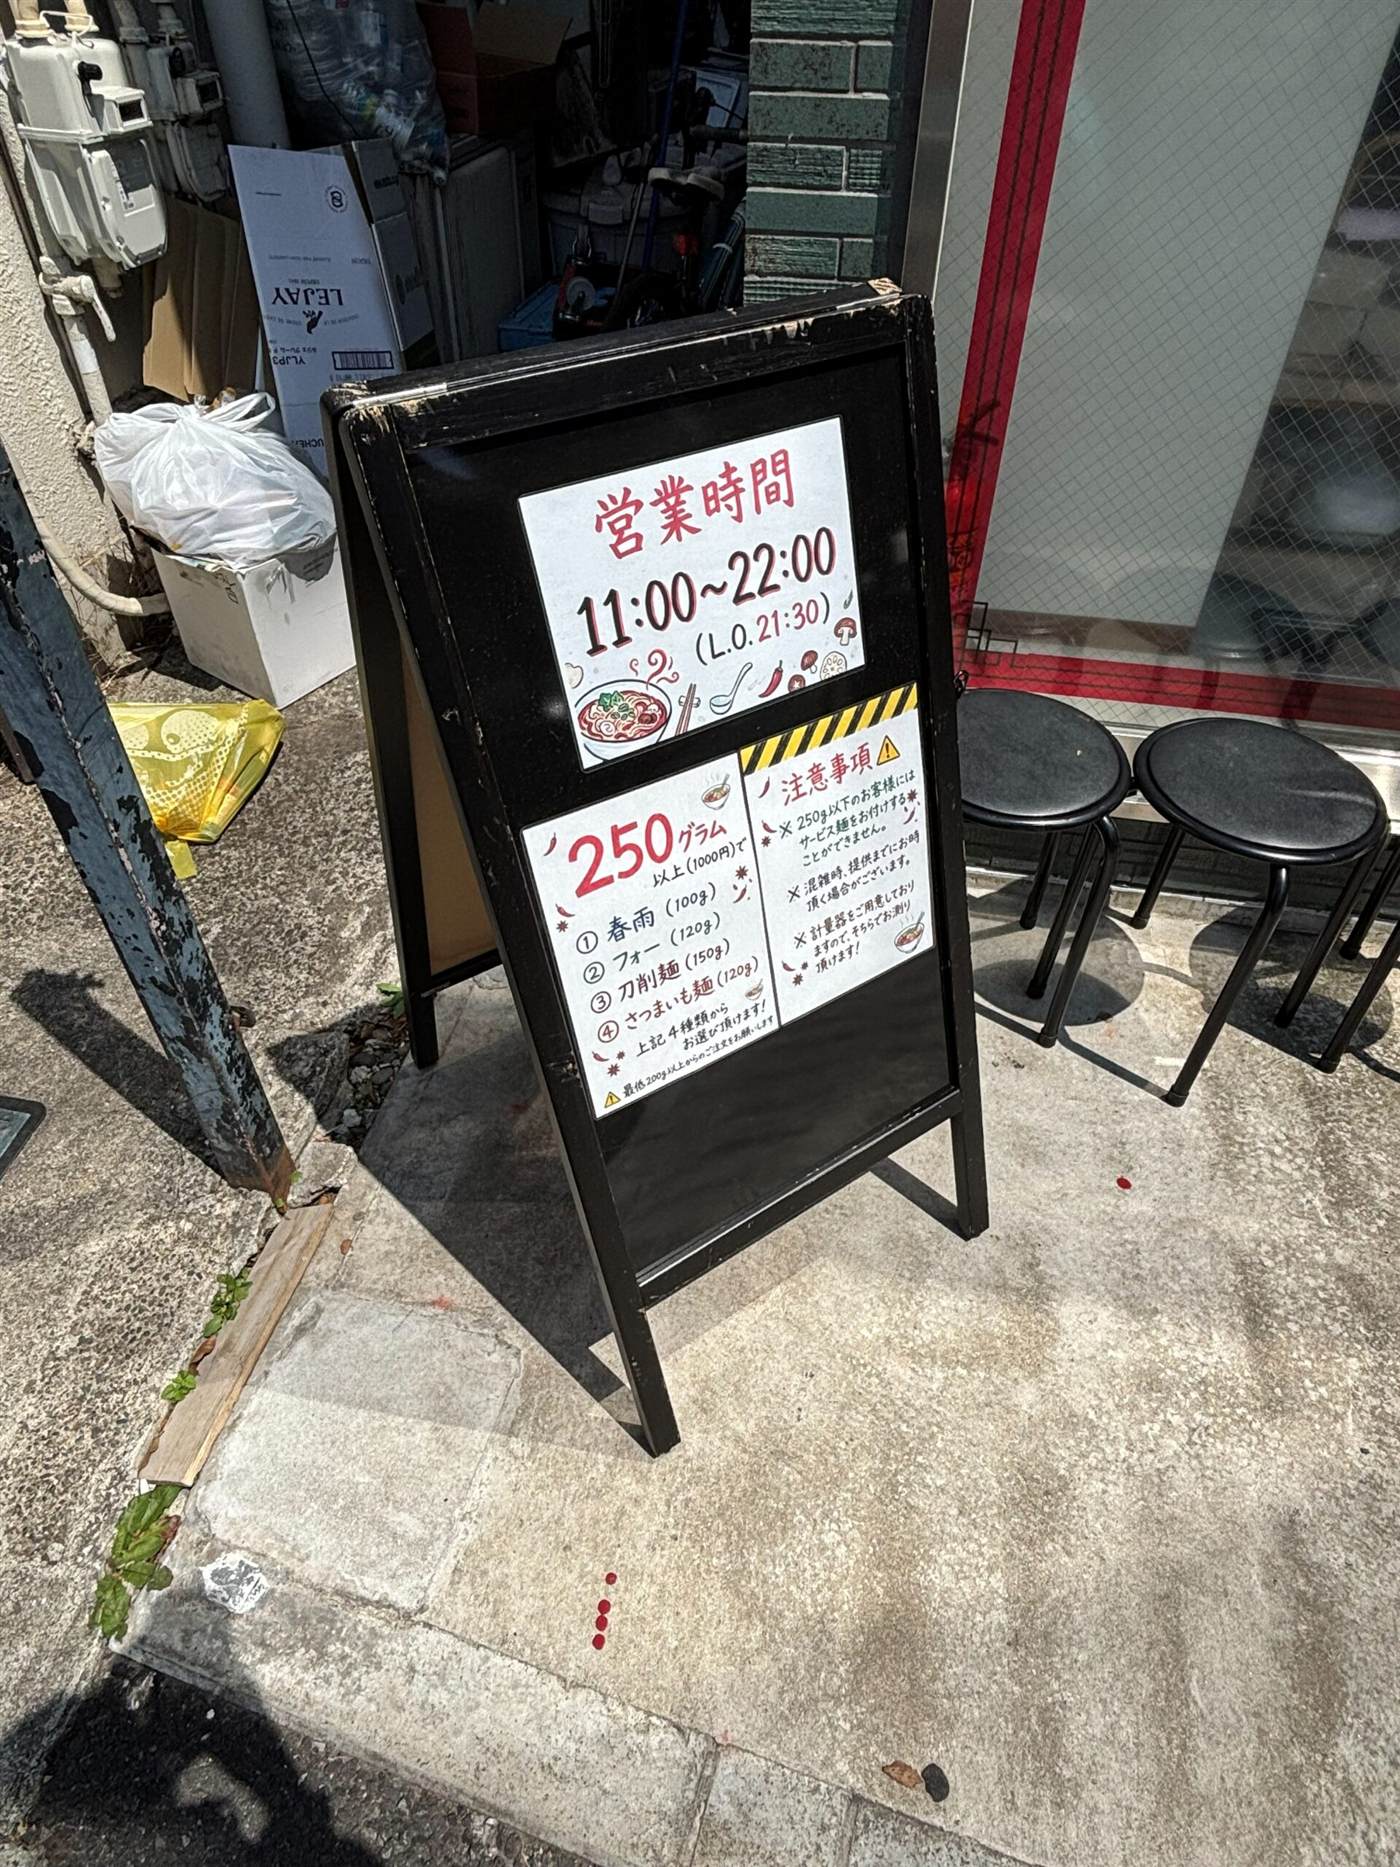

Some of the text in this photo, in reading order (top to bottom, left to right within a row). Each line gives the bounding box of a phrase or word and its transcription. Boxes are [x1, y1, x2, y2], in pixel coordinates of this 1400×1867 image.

[271, 287, 344, 306] LEJAY
[595, 449, 795, 560] 営業時間
[782, 742, 873, 806] 注意事項
[797, 770, 916, 830] 250g以下のお客様には
[803, 824, 887, 866] ことができません。
[607, 906, 655, 942] 春雨
[666, 882, 716, 917] (100g)
[613, 943, 660, 971] フォー
[670, 912, 720, 947] (120g)
